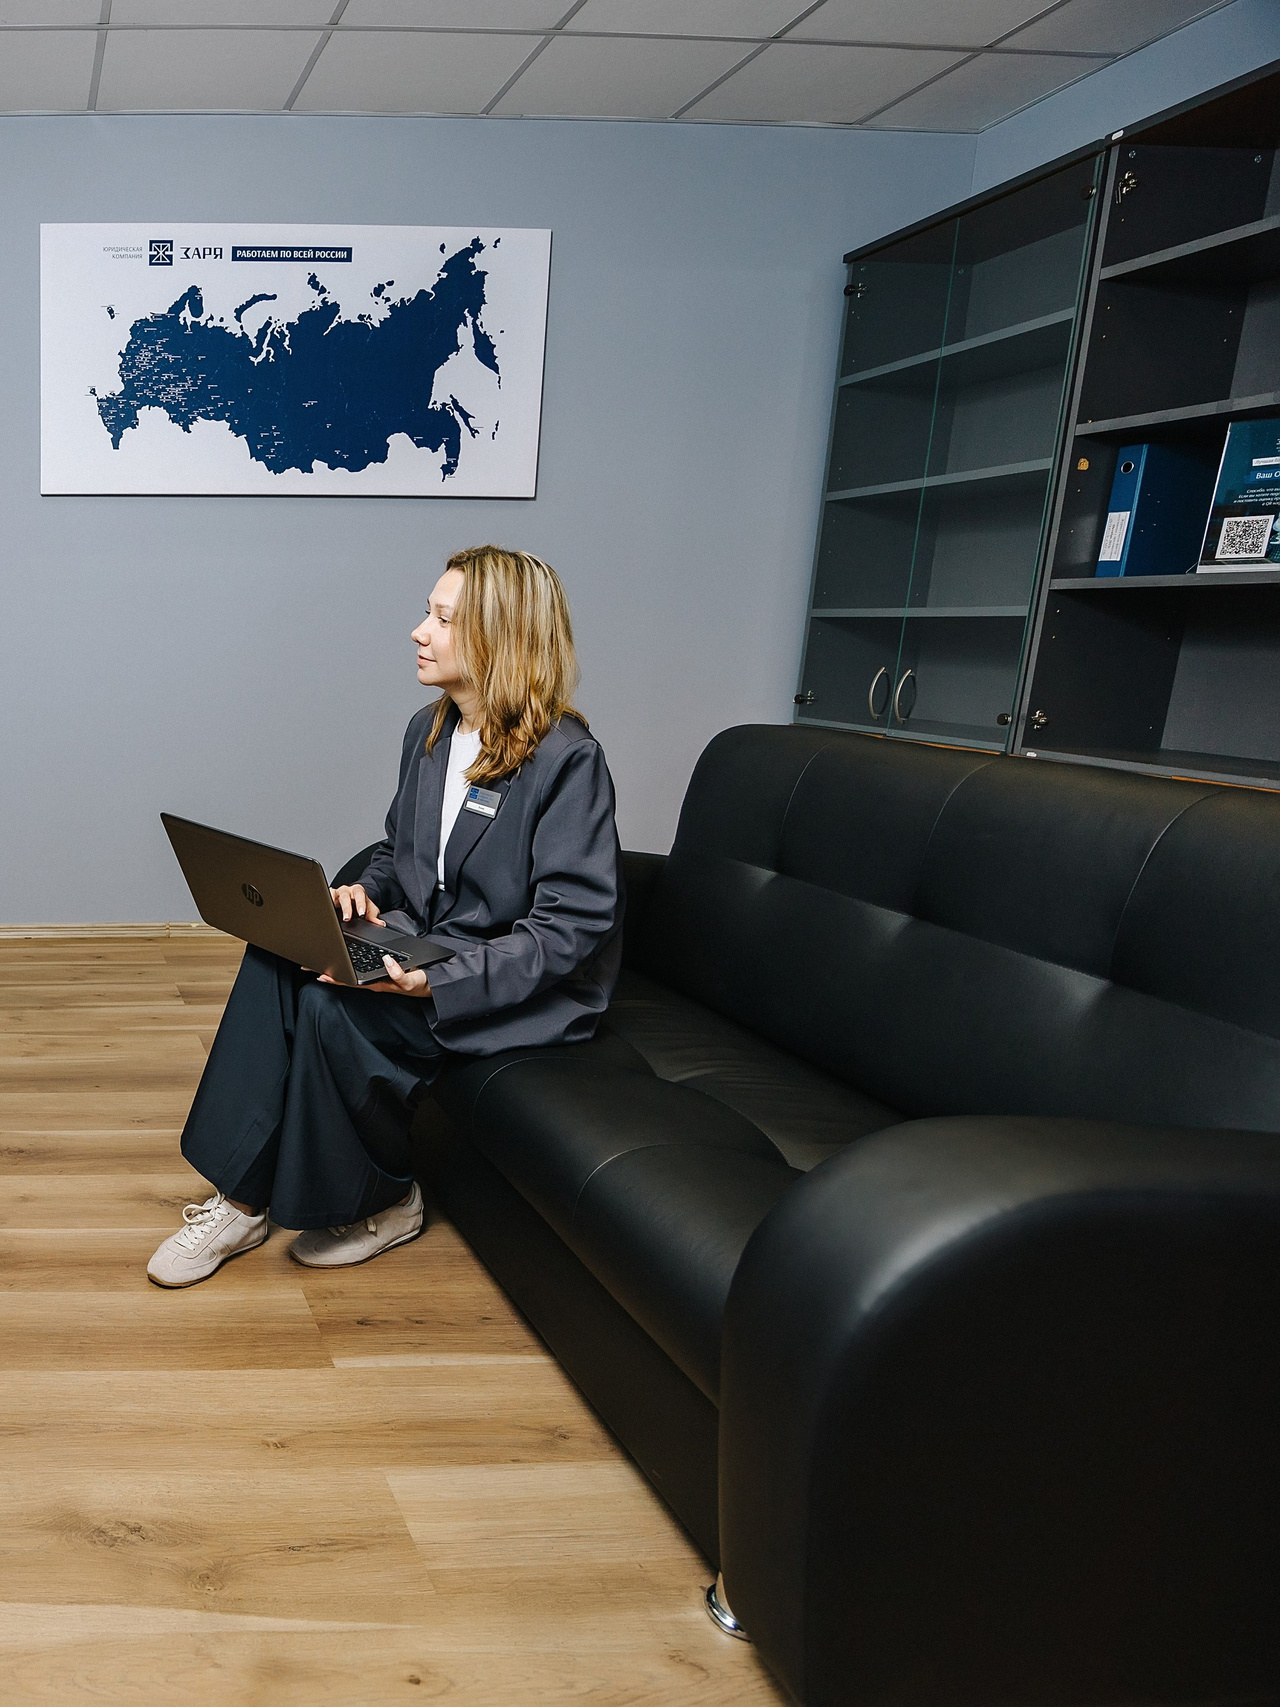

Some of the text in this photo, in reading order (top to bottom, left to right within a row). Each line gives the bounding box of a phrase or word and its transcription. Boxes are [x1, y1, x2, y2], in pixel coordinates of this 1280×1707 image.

[179, 246, 223, 260] ЗАРЯ
[236, 249, 348, 259] РАБОТАЕМ ПО ВСЕЙ РОССИИ
[245, 884, 261, 906] hp
